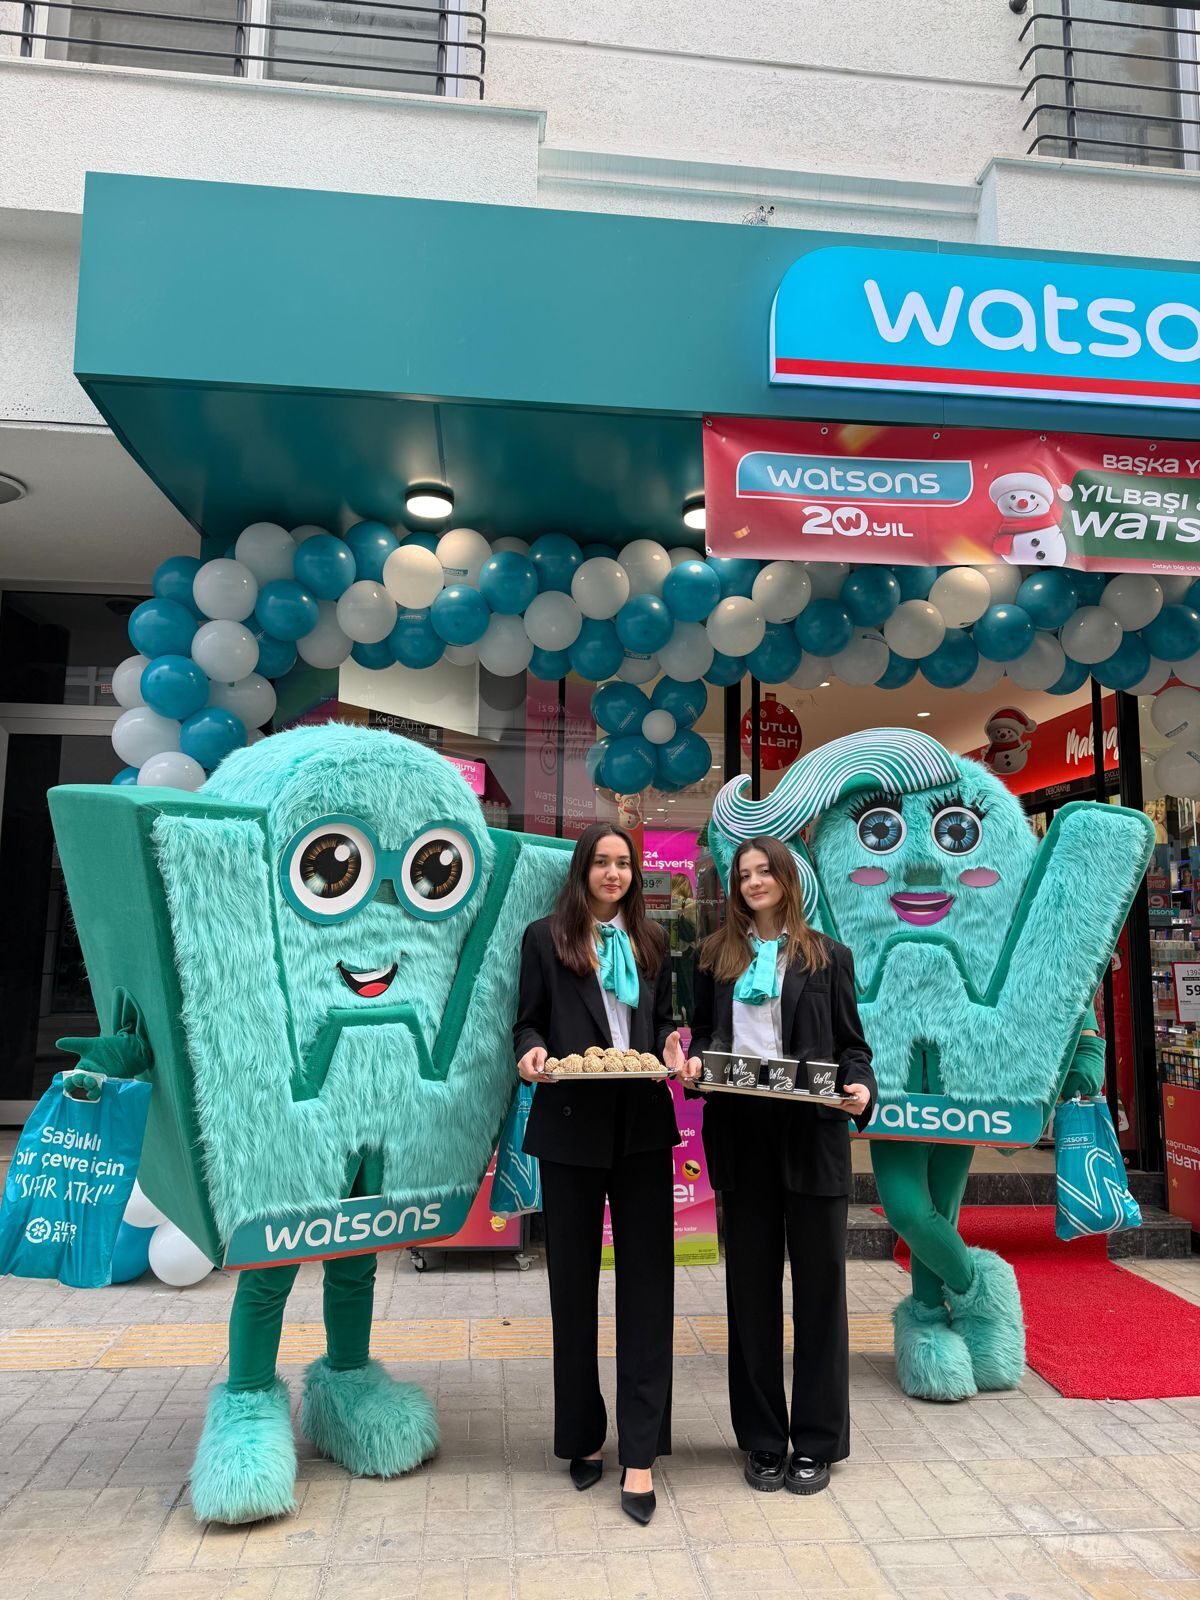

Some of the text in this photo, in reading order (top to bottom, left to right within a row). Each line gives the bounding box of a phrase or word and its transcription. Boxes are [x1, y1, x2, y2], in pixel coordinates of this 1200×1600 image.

[767, 465, 940, 494] watsons
[42, 1153, 89, 1173] çevre
[90, 1157, 125, 1178] için
[265, 1203, 441, 1252] watsons
